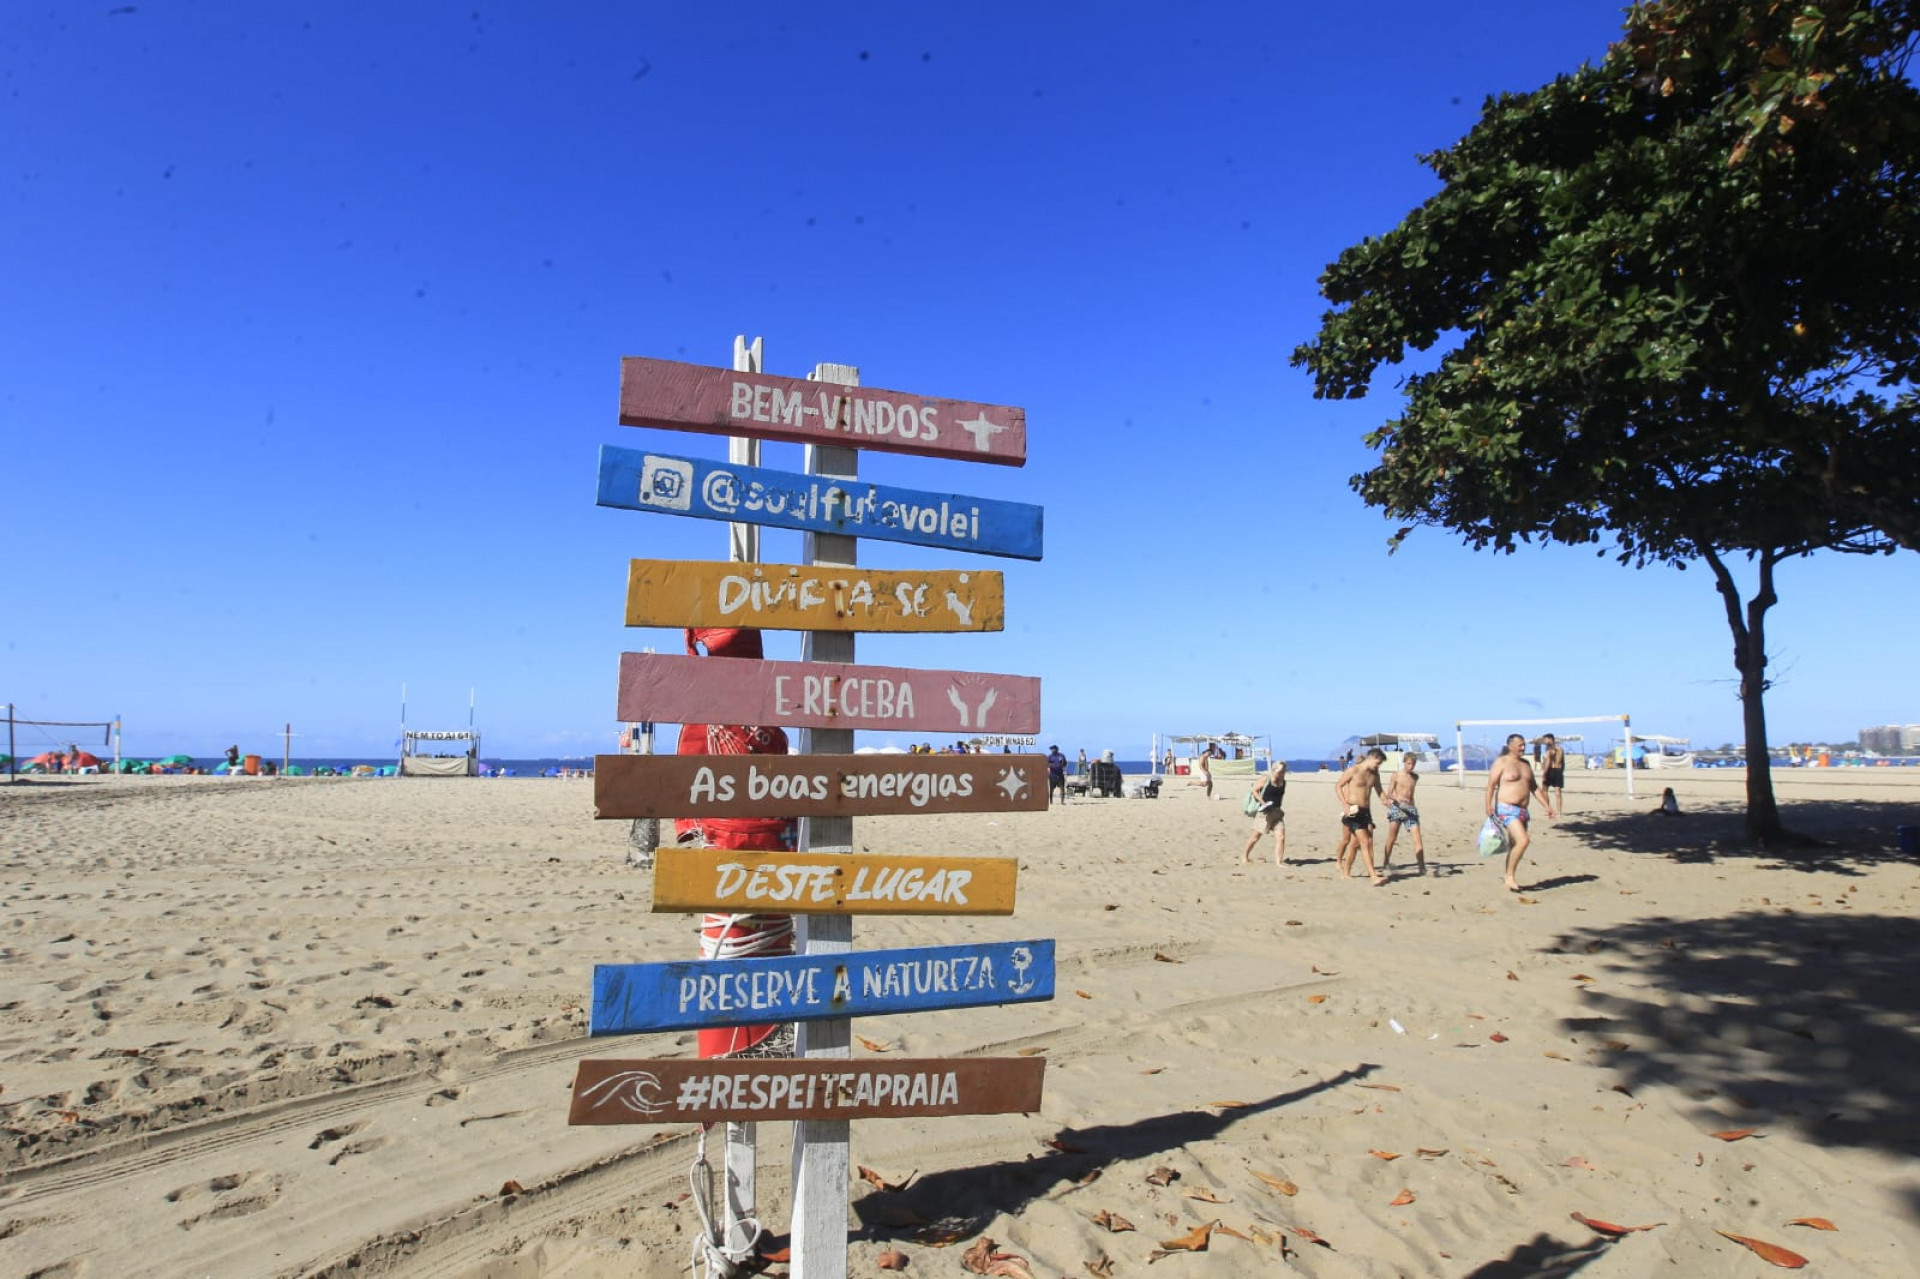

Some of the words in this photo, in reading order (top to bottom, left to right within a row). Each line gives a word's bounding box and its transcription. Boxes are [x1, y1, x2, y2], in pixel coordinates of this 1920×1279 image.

[775, 675, 793, 717] E
[803, 675, 915, 720] RECEBA
[690, 767, 736, 804] As
[749, 766, 828, 800] boas
[841, 772, 973, 807] energias
[715, 863, 839, 902] DESTE
[846, 866, 972, 905] LUGAR
[679, 967, 821, 1013] PRESERVE
[834, 966, 852, 1002] A
[863, 955, 995, 998] NATUREZA
[676, 1071, 959, 1111] #RESPEITEAPRAIA
